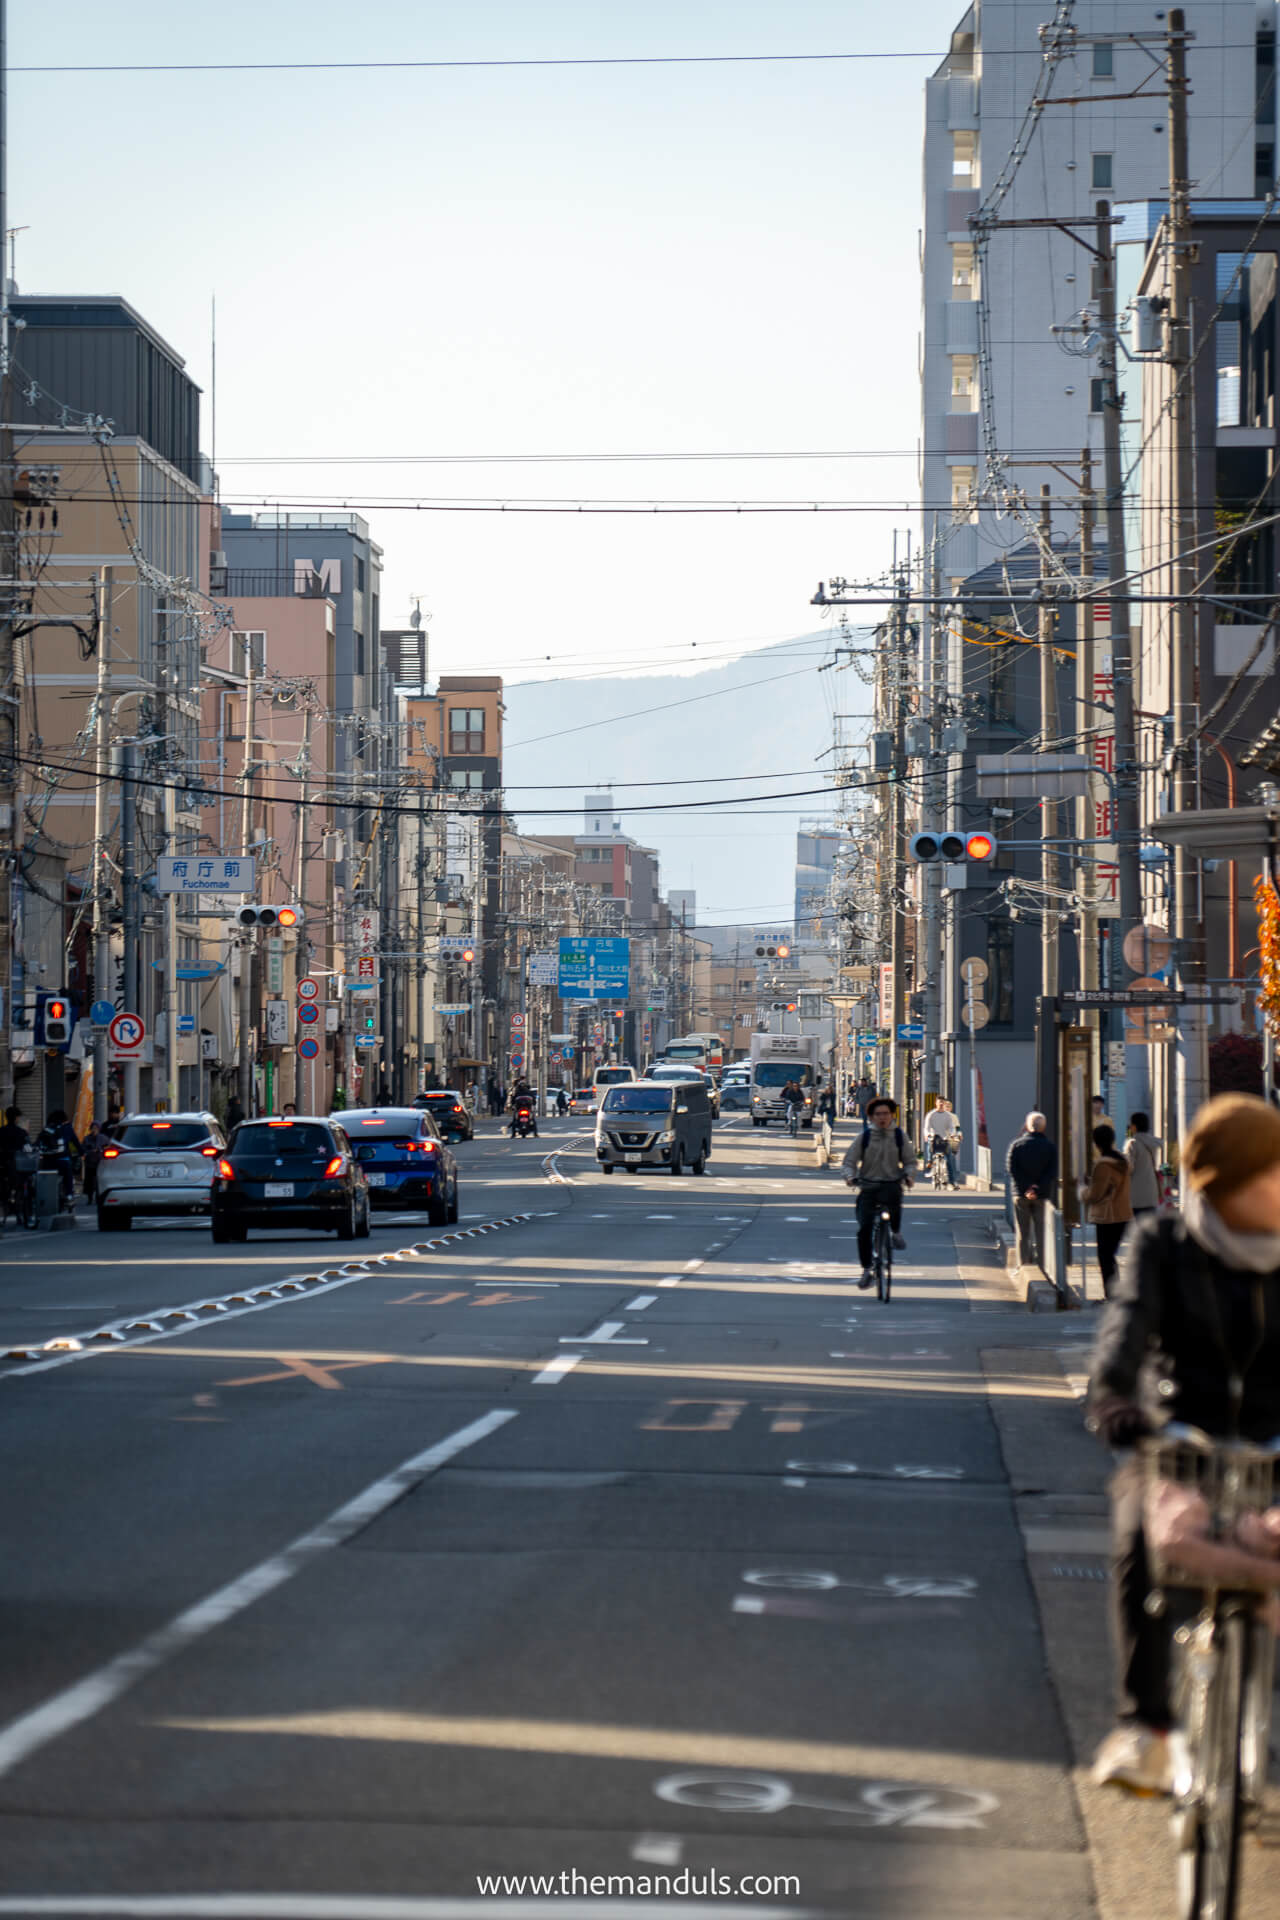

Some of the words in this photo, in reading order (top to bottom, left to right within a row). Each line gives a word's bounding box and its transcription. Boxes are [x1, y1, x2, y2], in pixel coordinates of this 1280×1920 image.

[172, 861, 240, 878] 府庁前
[182, 879, 230, 889] Fuchomae
[302, 984, 314, 995] 40
